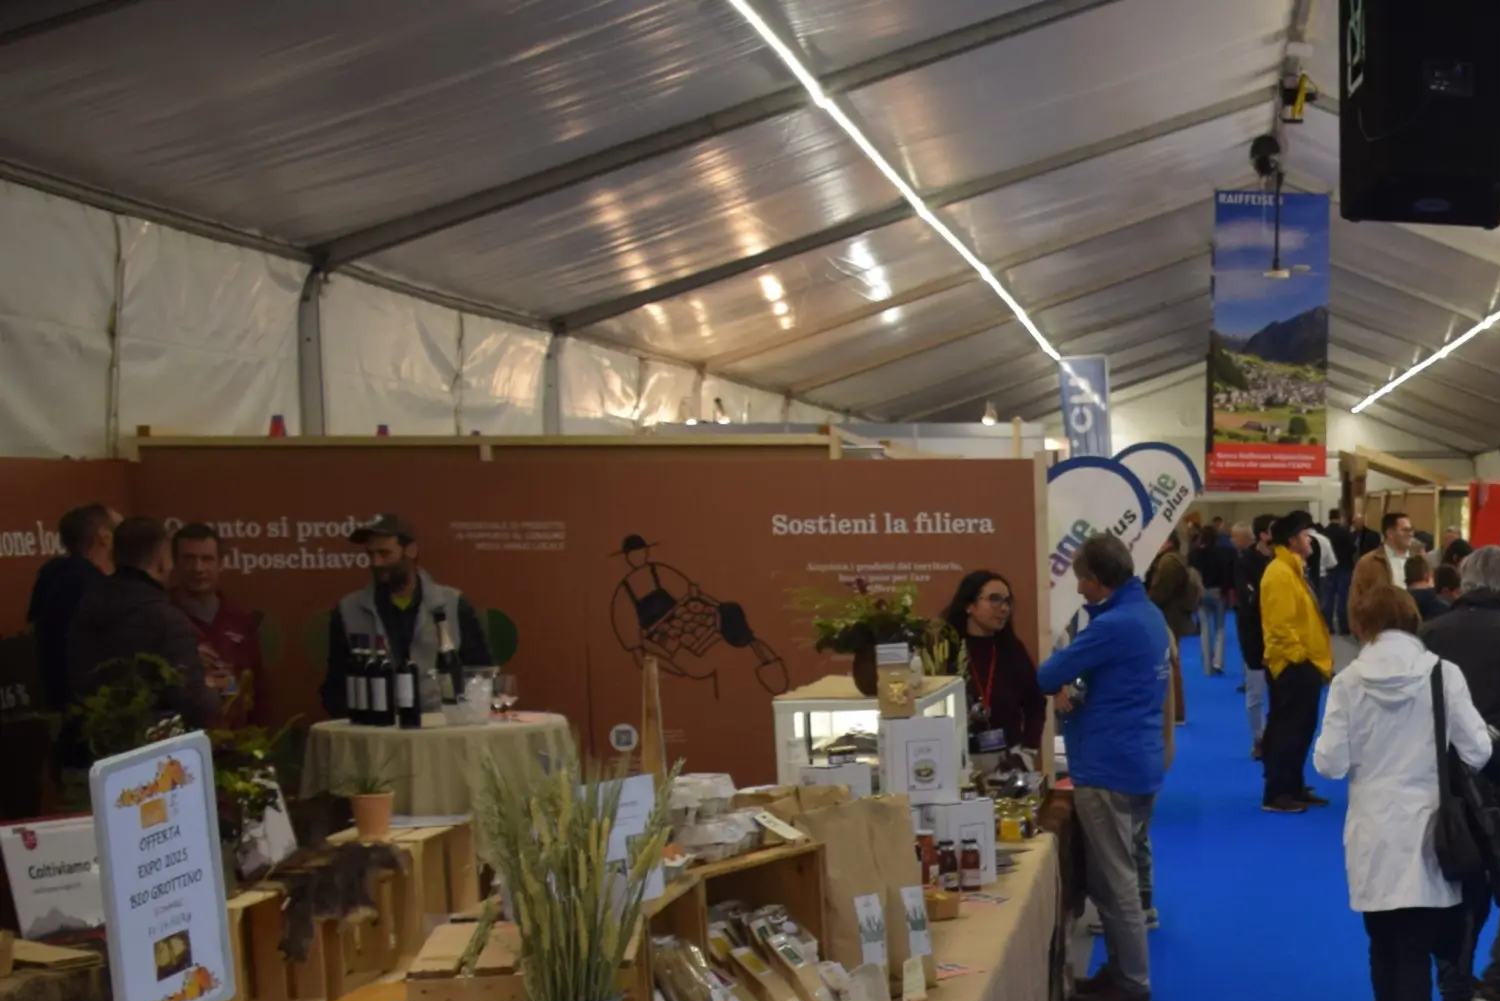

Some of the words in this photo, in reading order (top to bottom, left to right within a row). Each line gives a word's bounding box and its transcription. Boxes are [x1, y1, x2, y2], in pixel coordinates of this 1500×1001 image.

[1162, 484, 1189, 523] plus
[267, 516, 289, 538] si
[771, 513, 879, 535] Sostieni
[884, 512, 909, 534] la
[914, 512, 996, 534] filiera
[28, 860, 91, 880] Coltiviamo
